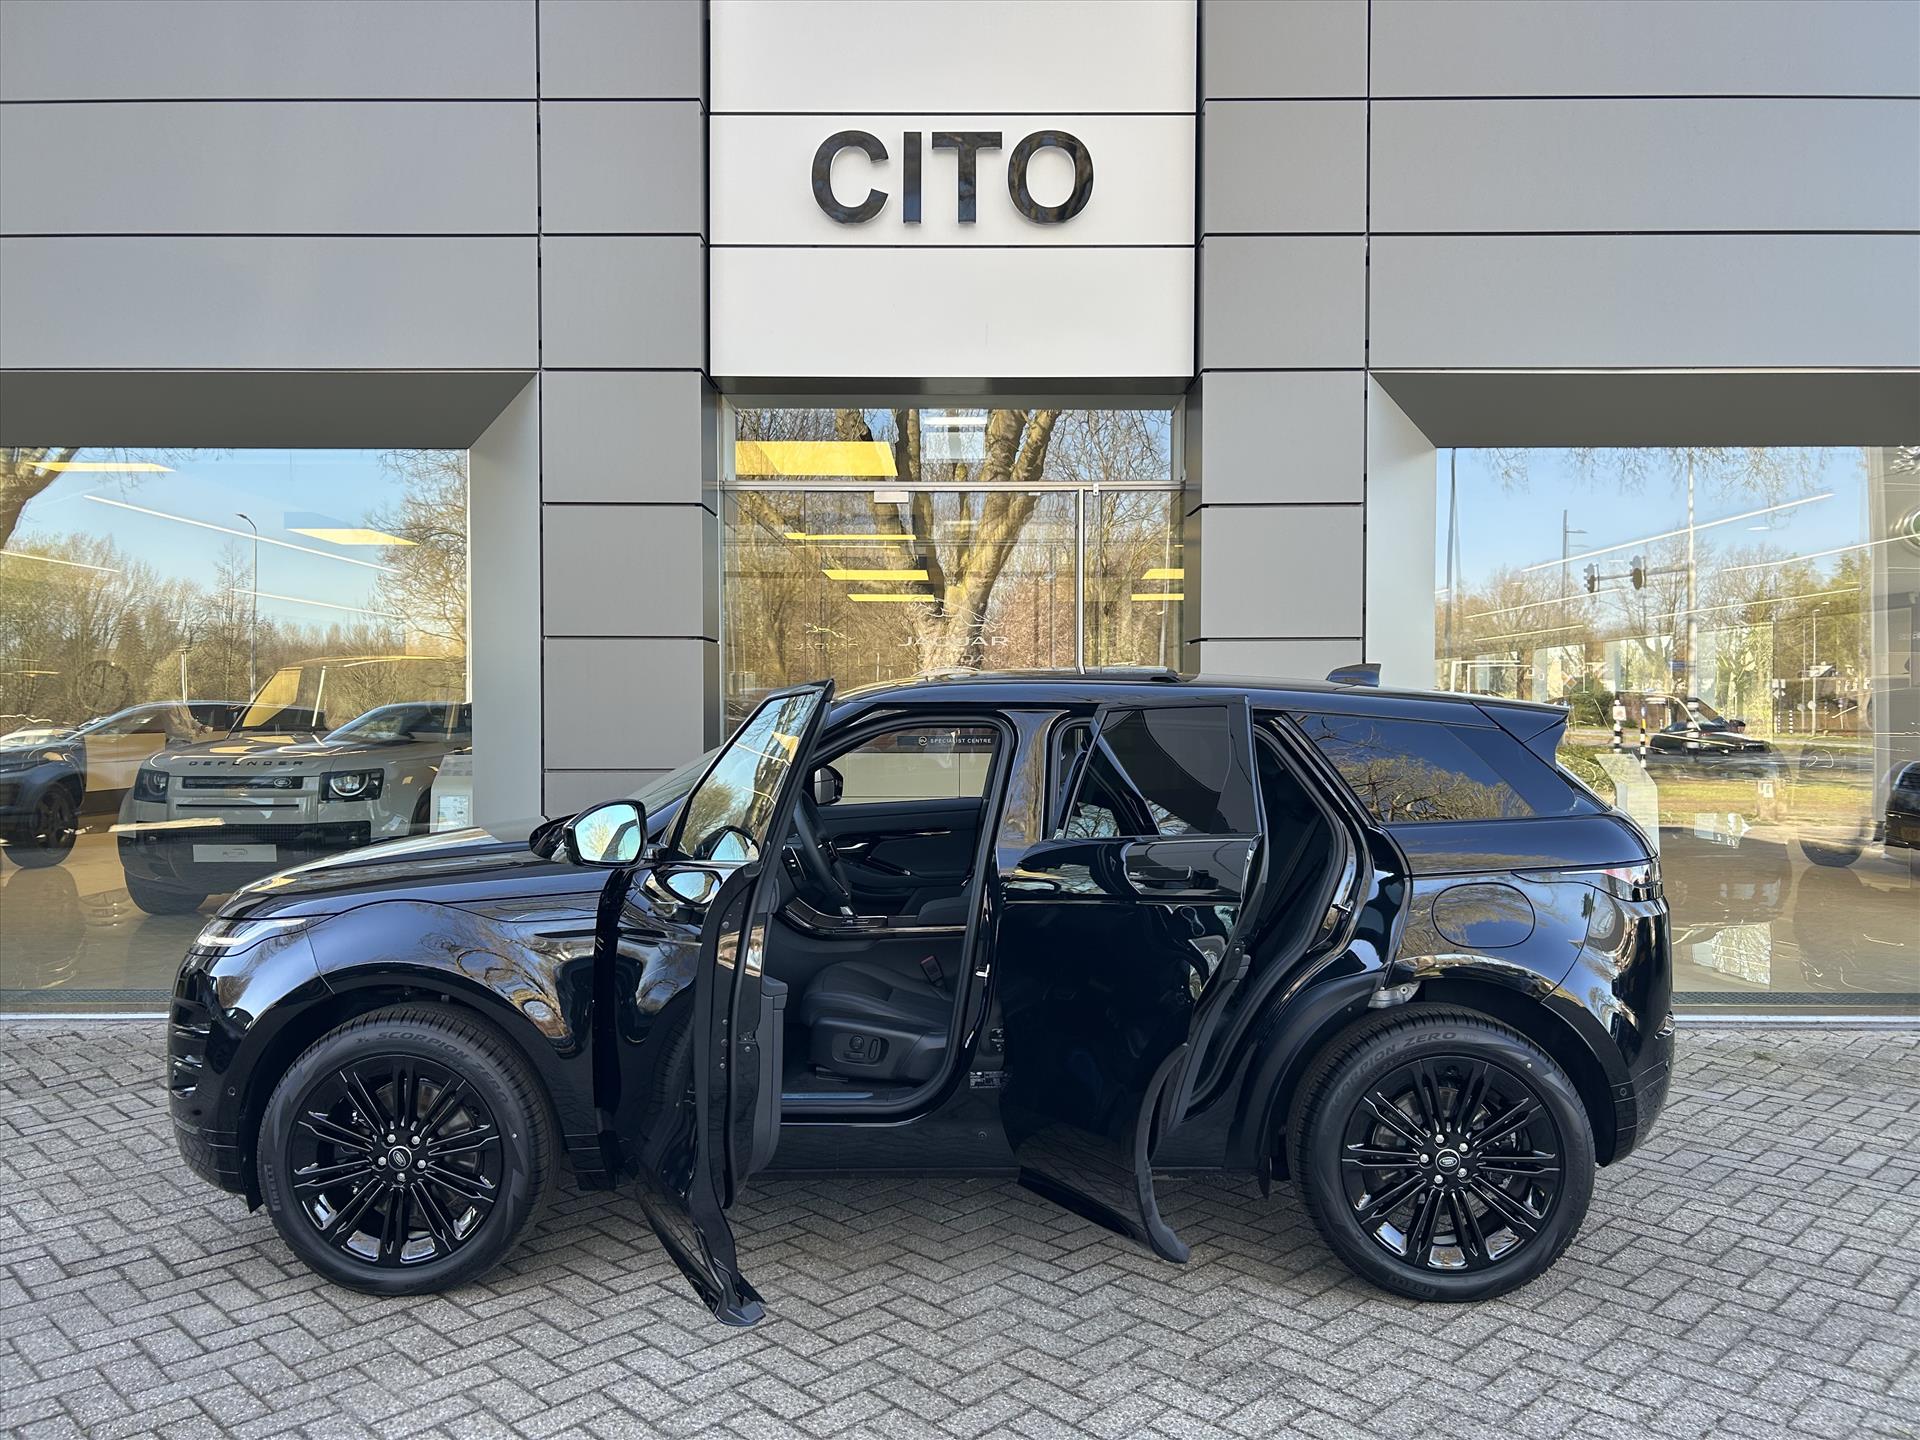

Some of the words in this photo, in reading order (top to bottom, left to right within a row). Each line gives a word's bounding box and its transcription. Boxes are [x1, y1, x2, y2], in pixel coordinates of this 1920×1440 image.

[811, 129, 1095, 225] CITO
[376, 1031, 470, 1059] SCORPION
[1404, 1031, 1458, 1049] ZERO
